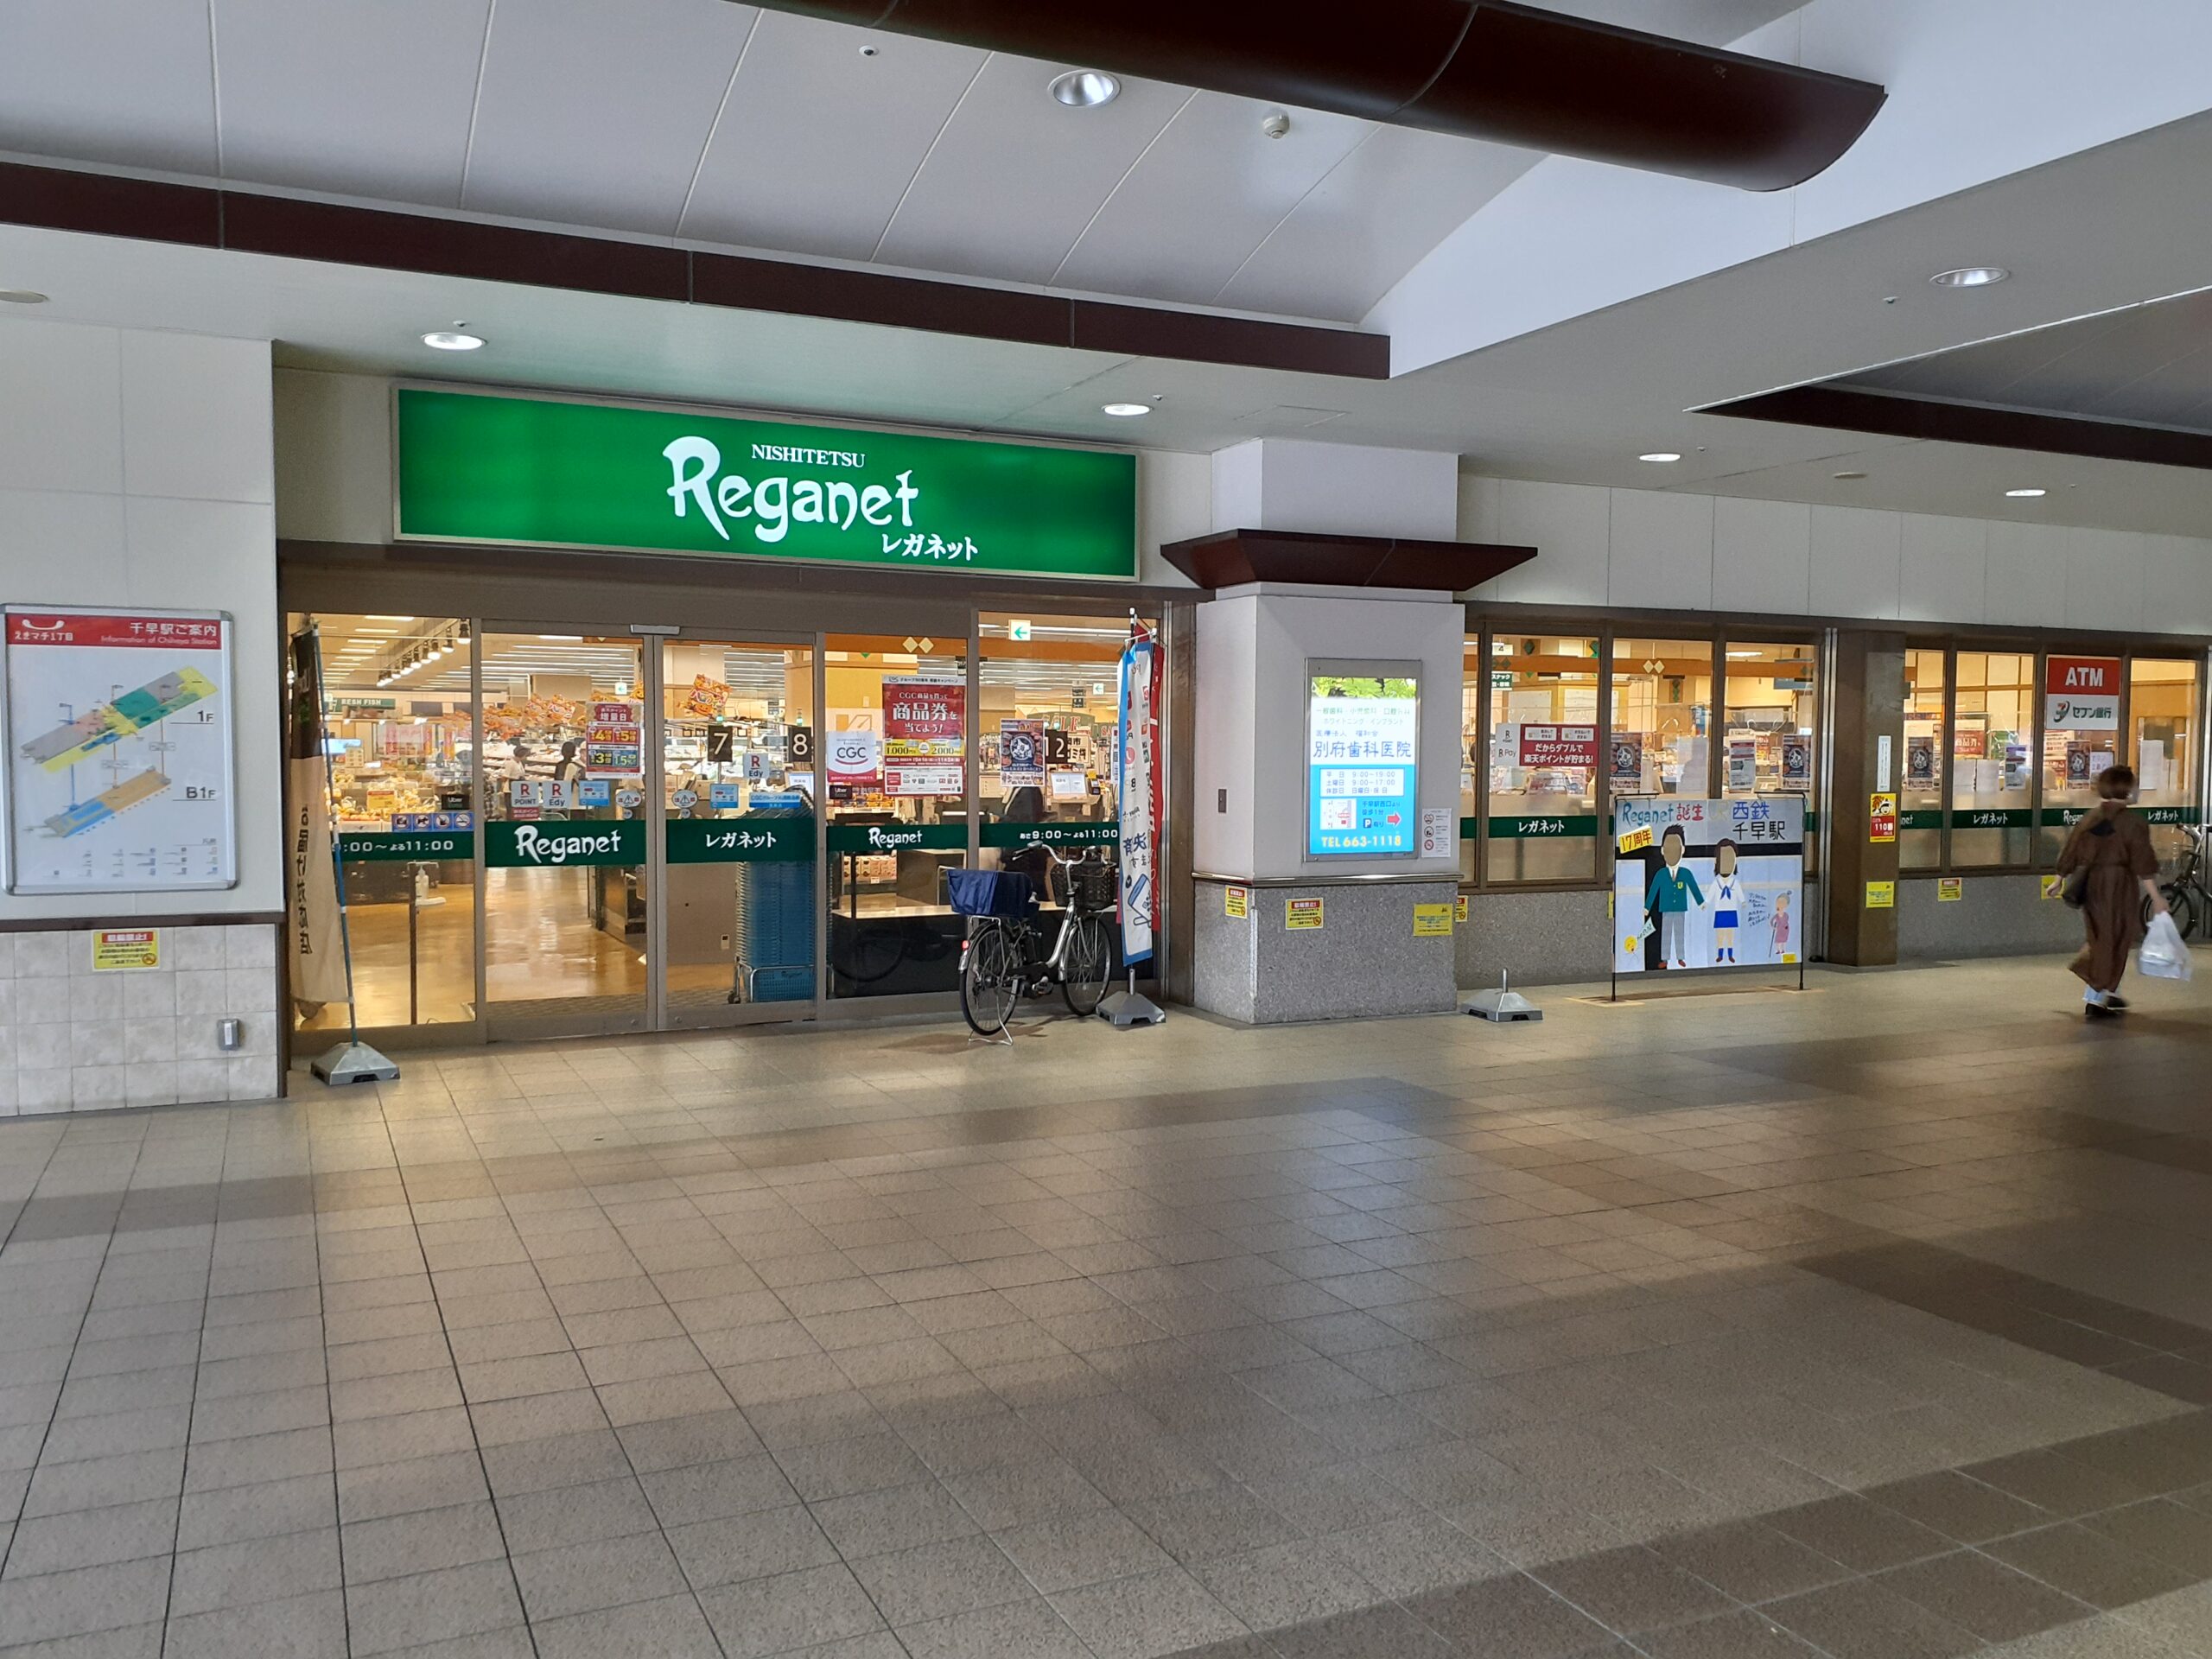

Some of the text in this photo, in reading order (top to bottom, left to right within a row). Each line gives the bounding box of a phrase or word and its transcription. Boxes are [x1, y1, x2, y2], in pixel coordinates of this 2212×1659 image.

[751, 443, 866, 469] NISHITETSU
[662, 435, 920, 543] Reganet
[880, 532, 980, 562] レガネット
[130, 621, 217, 637] 千早駅ご案内
[100, 635, 146, 644] Information
[2065, 666, 2103, 687] ATM
[196, 709, 214, 723] 1F
[893, 702, 958, 721] 商品券を
[2072, 706, 2112, 719] セブン銀行
[713, 733, 729, 755] 7
[792, 734, 808, 755] 8
[1313, 741, 1412, 758] 別府歯科医院
[1535, 744, 1584, 753] だからダブルで
[836, 747, 867, 759] CGC
[748, 769, 764, 778] Edy
[186, 785, 216, 799] B1F
[549, 798, 565, 807] Edy
[1732, 801, 1770, 820] 西鉄
[1622, 802, 1705, 827] Reganet 誕生
[1973, 808, 2009, 824] レガネット
[2147, 810, 2179, 822] レガネット
[1517, 819, 1566, 834] レガネット
[1732, 821, 1786, 841] 千早駅
[513, 824, 622, 864] Reganet
[705, 831, 777, 849] レガネット
[868, 827, 923, 849] Reganet
[1321, 836, 1340, 848] TEL
[1621, 830, 1653, 852] 17周年
